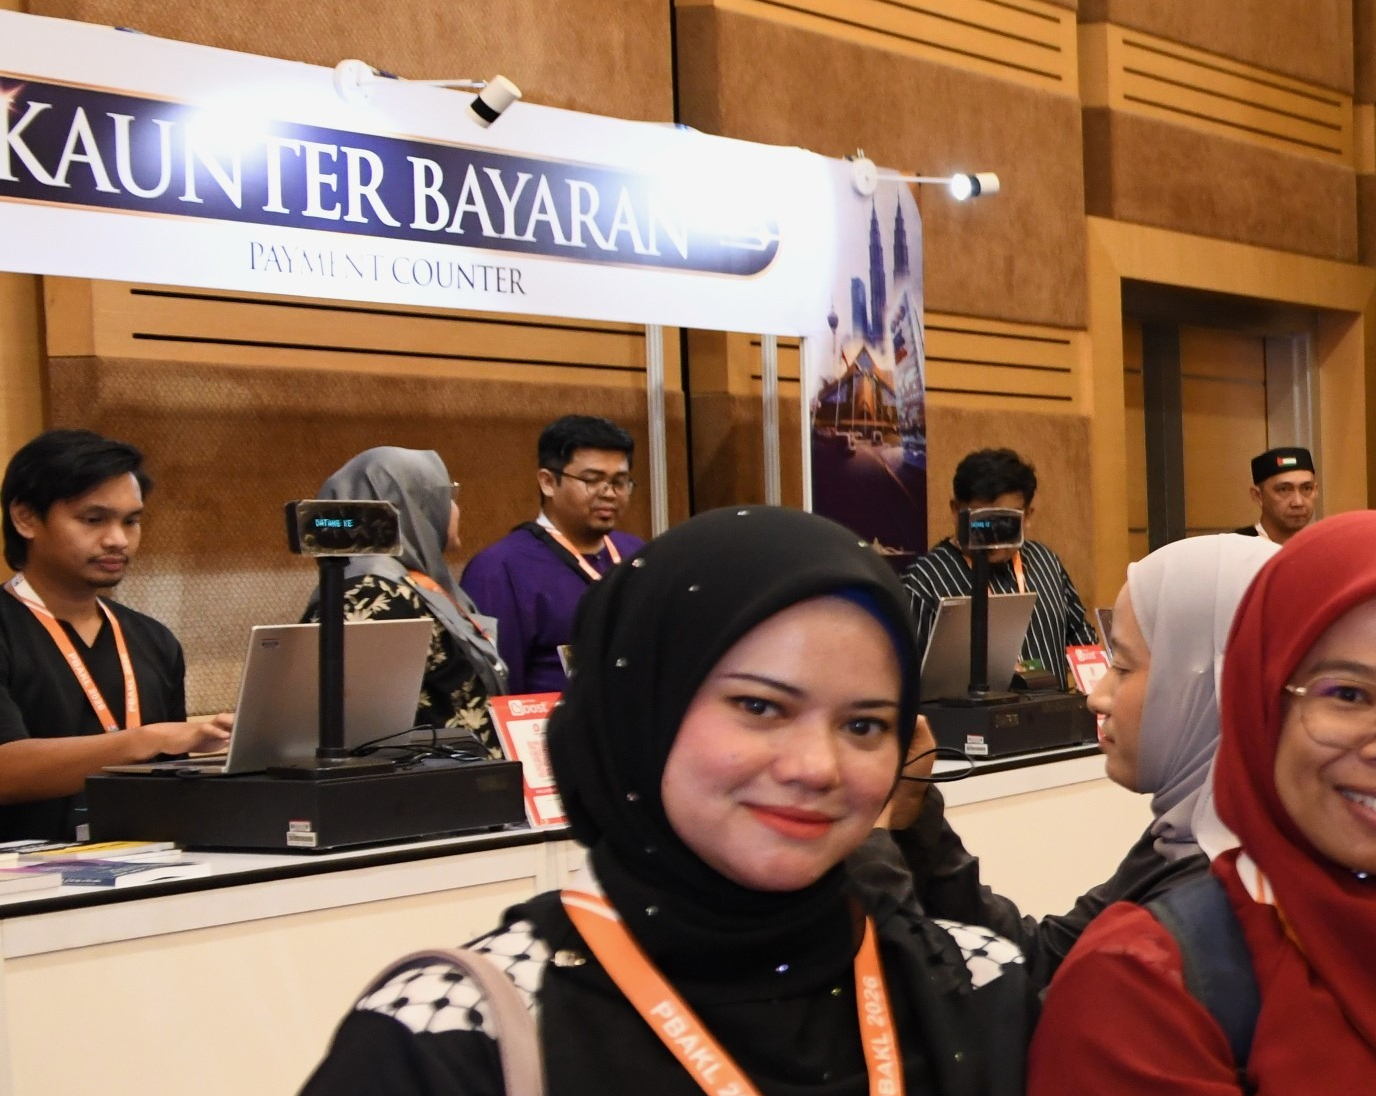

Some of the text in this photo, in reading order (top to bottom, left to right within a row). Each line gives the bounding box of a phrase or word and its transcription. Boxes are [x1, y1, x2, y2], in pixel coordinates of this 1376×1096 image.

[0, 97, 690, 260] KAUNTER BAYARAN
[248, 240, 526, 296] PAYMENT COUNTER
[862, 975, 885, 1028] 2026
[649, 999, 723, 1085] PBAKL
